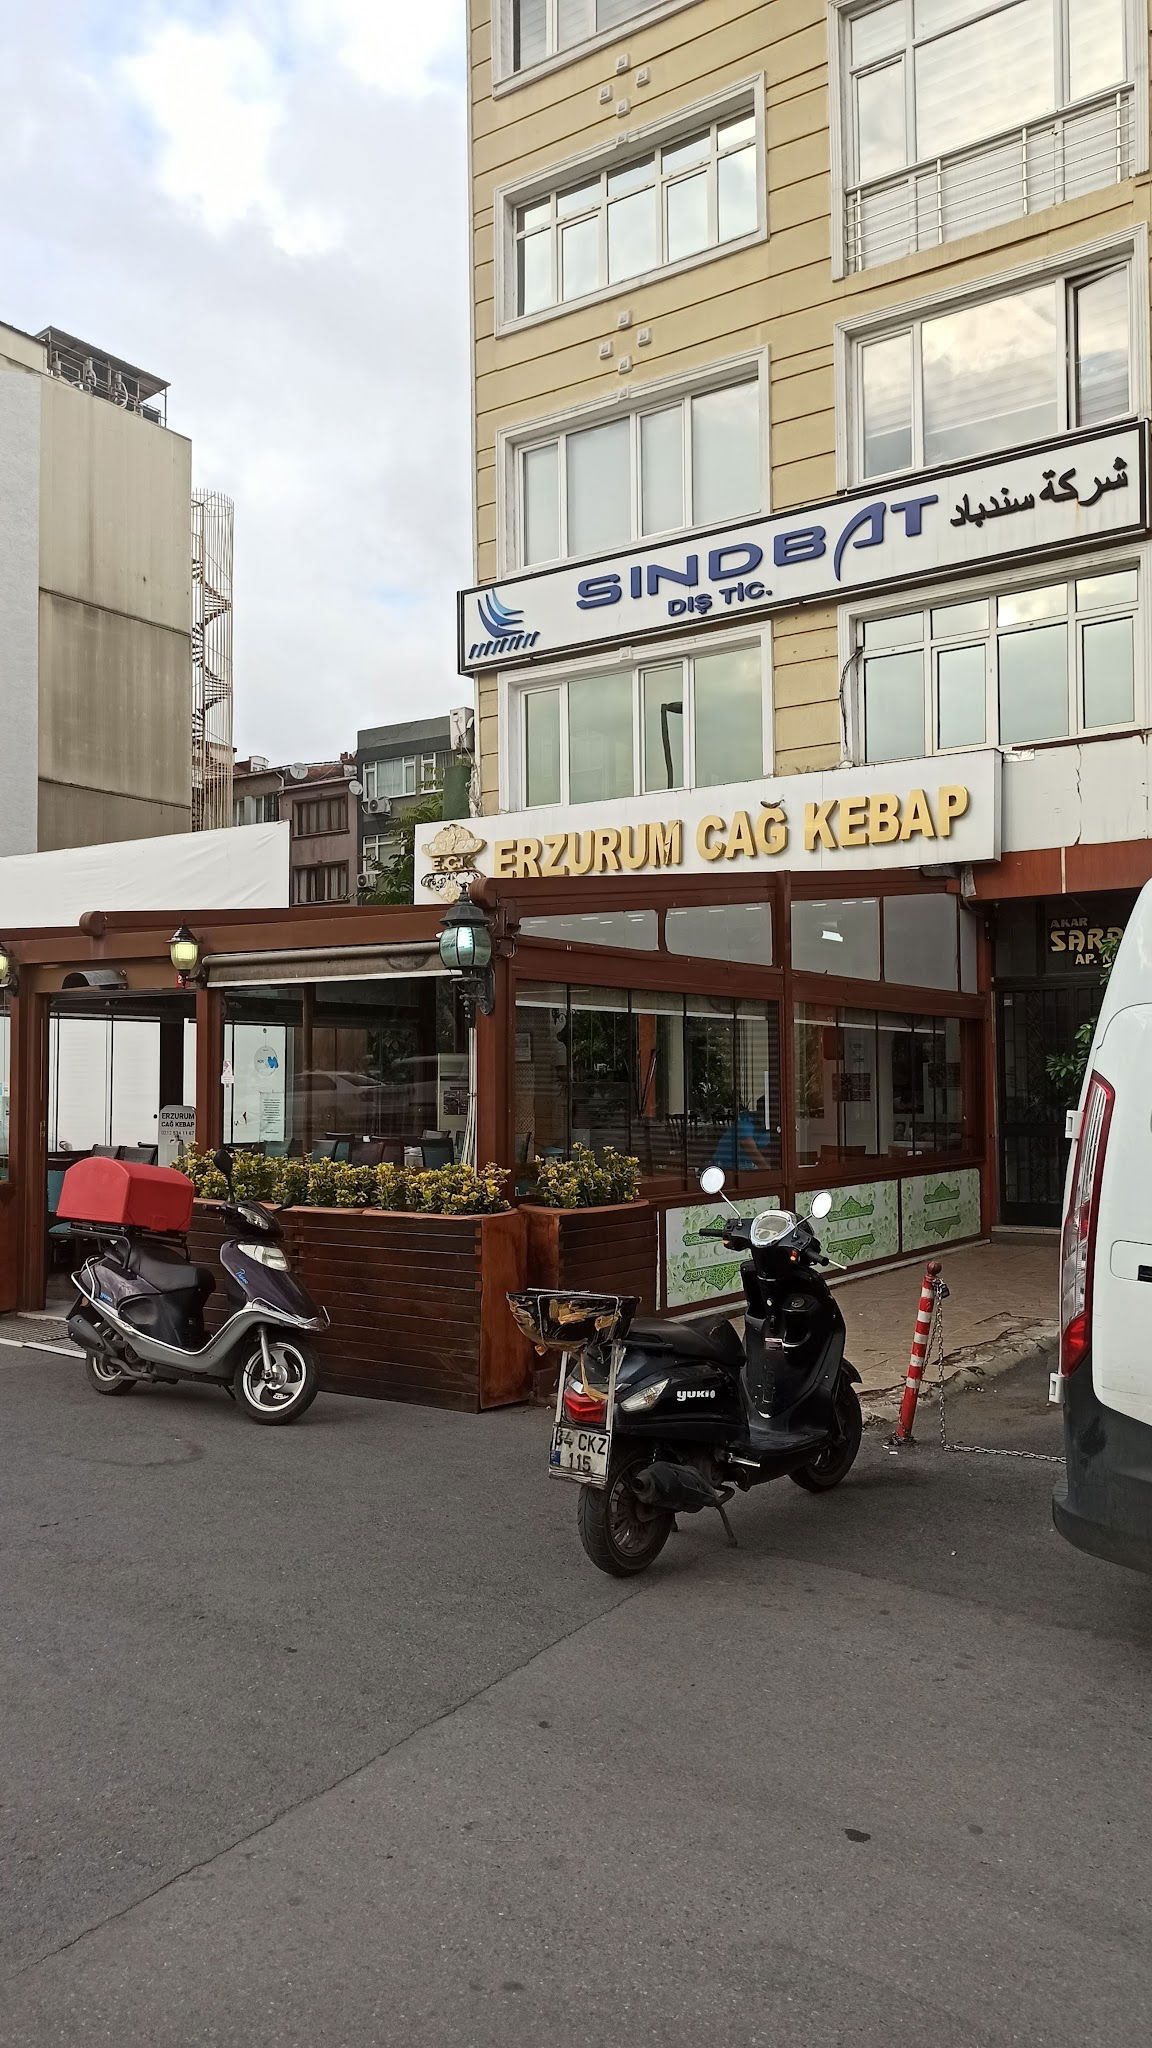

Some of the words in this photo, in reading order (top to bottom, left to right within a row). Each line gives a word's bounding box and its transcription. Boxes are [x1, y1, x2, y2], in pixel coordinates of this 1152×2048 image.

[1039, 456, 1129, 507] شركة
[950, 487, 1036, 528] سندباد
[576, 494, 939, 609] SINDBAT
[667, 593, 713, 616] DIŞ
[719, 581, 773, 605] TİC.
[493, 819, 683, 878] ERZURUM
[696, 799, 789, 862] CAĞ
[803, 784, 970, 851] KEBAP
[1050, 917, 1088, 928] AKAR
[1075, 953, 1098, 964] AP.
[161, 1112, 195, 1120] ERZURUM
[578, 1432, 607, 1455] CKZ
[568, 1452, 592, 1473] 115
